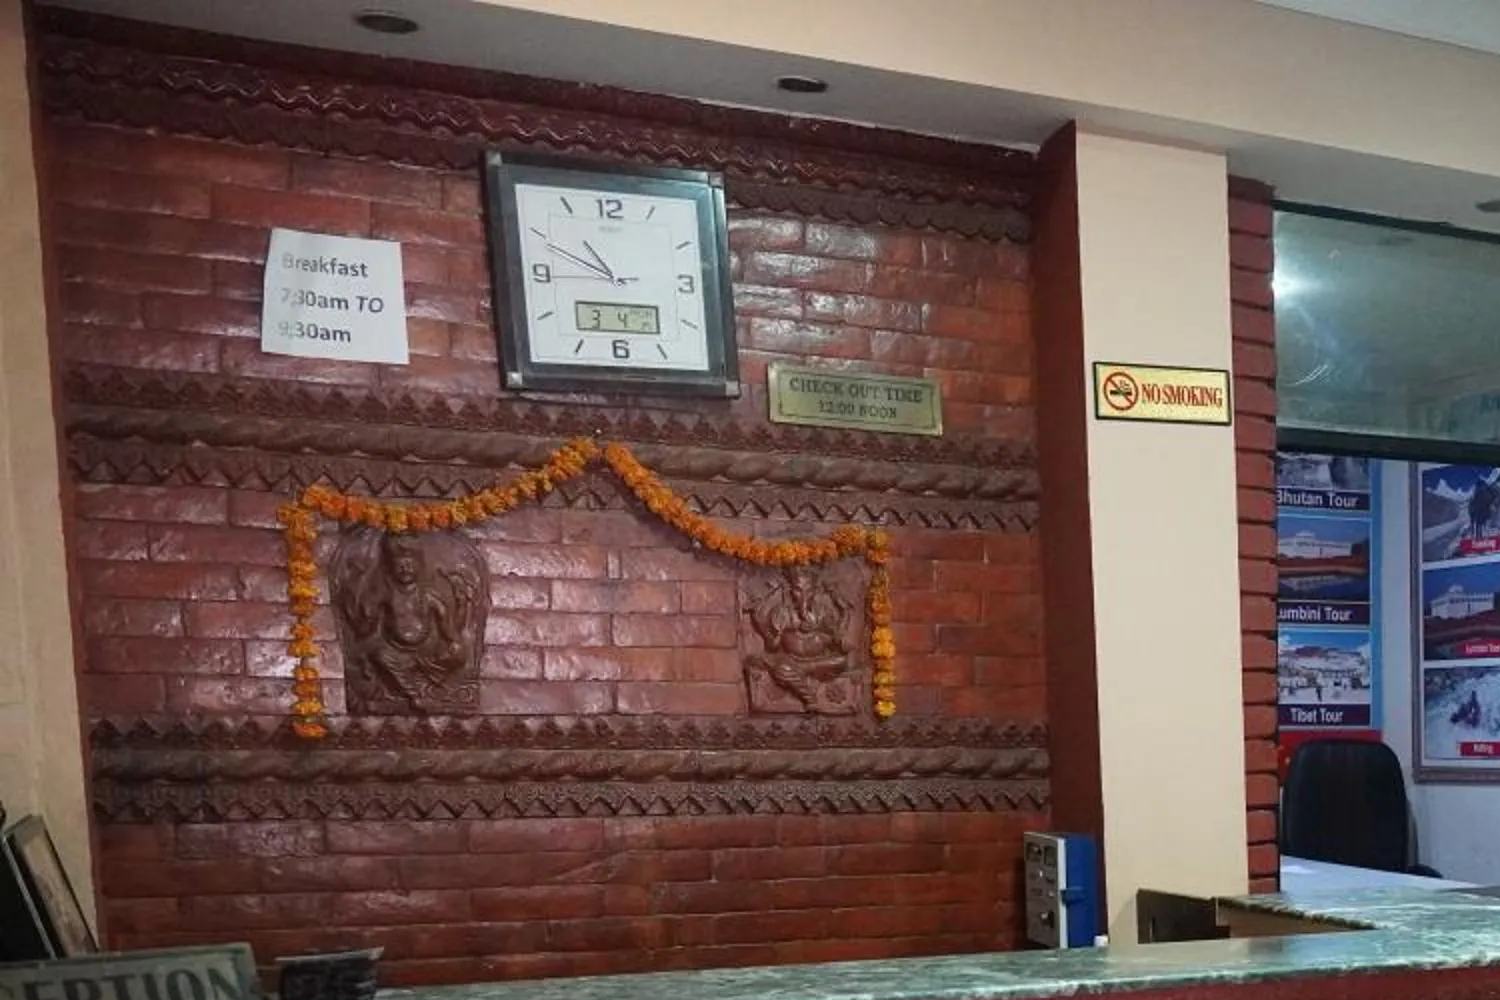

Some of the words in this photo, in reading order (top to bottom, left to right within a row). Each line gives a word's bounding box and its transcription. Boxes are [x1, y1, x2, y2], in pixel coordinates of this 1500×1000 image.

[595, 199, 624, 220] 12
[281, 252, 368, 278] Breakfast
[532, 263, 551, 284] 9
[677, 274, 695, 294] 3
[355, 295, 384, 314] TO
[612, 339, 630, 359] 6
[789, 377, 843, 396] CHECK
[848, 382, 879, 400] OUT
[885, 386, 923, 403] TIME
[1141, 383, 1160, 404] NO
[1162, 384, 1223, 408] SMOKING
[1327, 492, 1358, 508] Tour
[1278, 605, 1321, 622] umbini
[1324, 606, 1351, 622] Tour
[1290, 707, 1317, 723] Tibet
[1319, 707, 1344, 723] Tour
